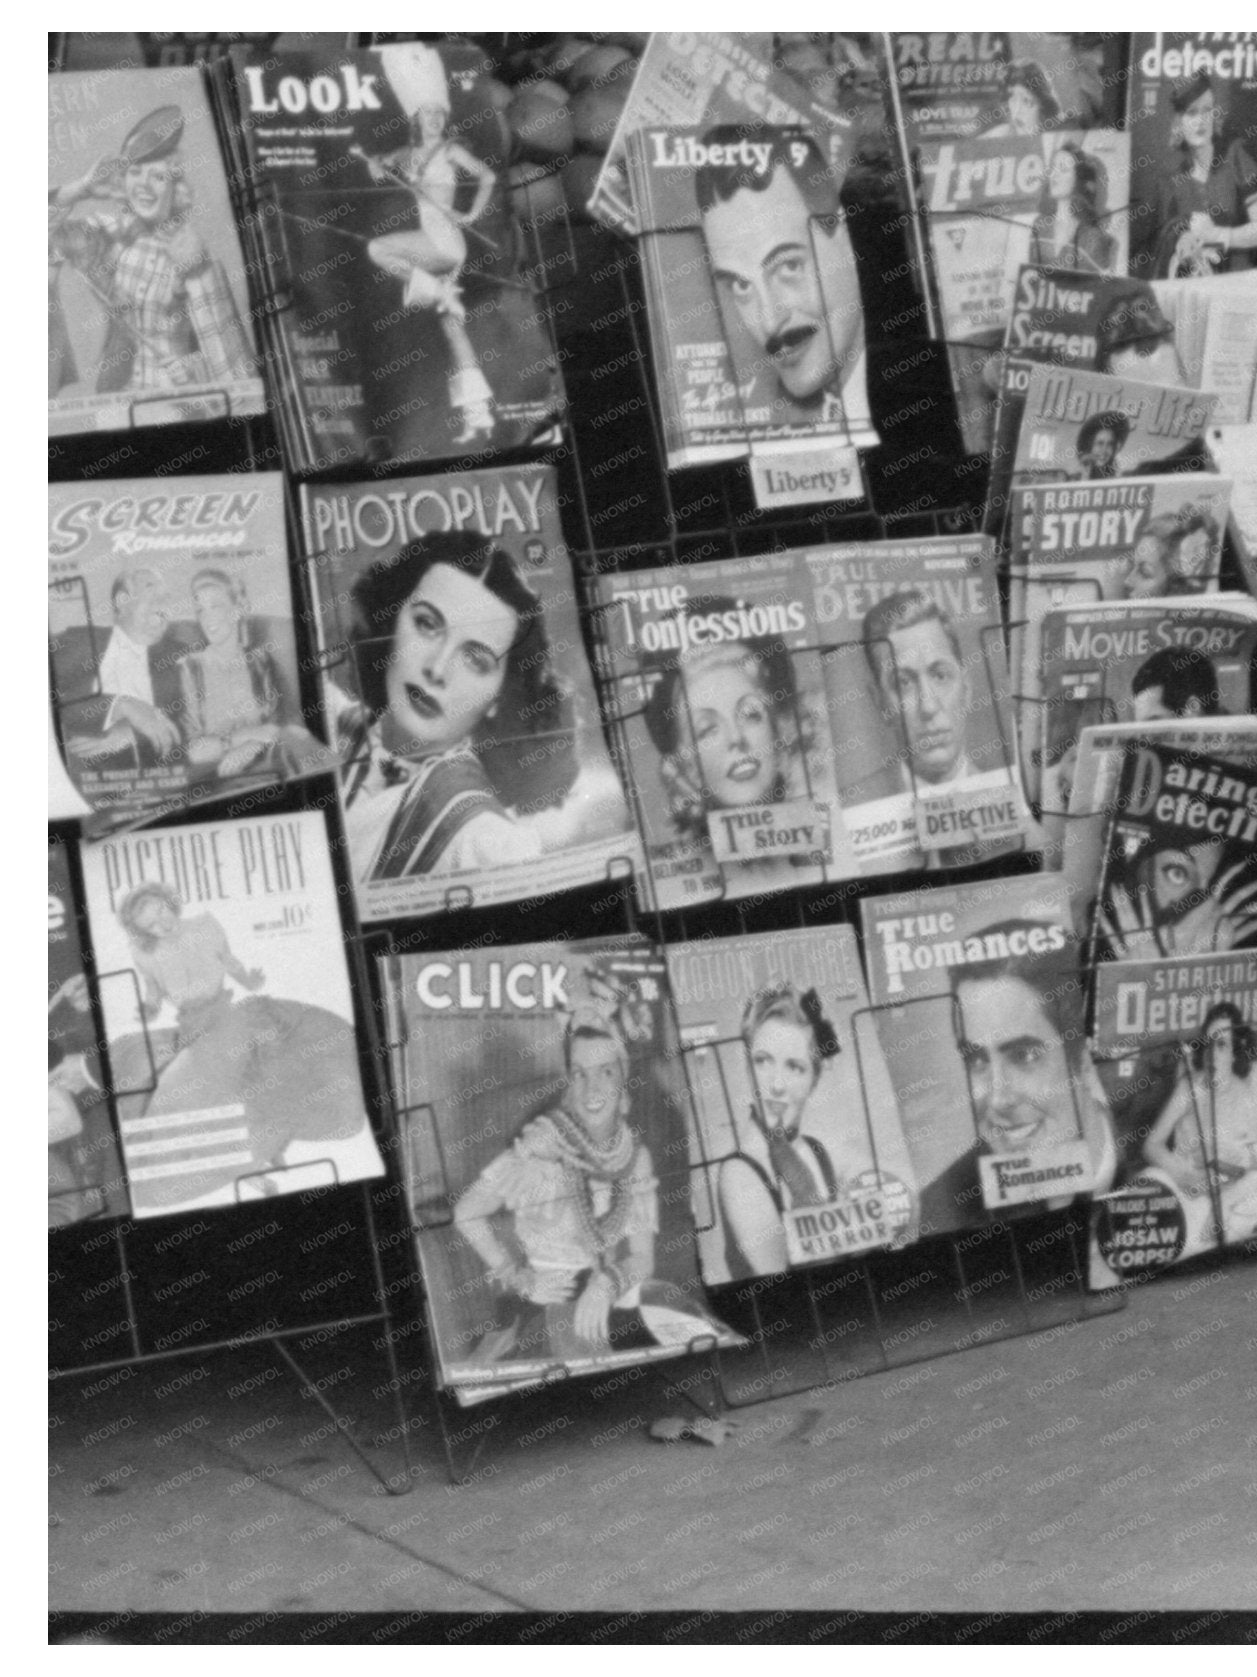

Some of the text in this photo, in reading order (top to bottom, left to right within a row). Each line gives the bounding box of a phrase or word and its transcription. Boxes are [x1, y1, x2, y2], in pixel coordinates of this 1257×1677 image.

[245, 64, 382, 113] Look
[650, 131, 773, 175] Liberty
[1016, 268, 1095, 314] Silver
[1013, 311, 1098, 359] Screen
[764, 467, 838, 495] Liberty
[48, 491, 262, 561] SCREEN
[314, 478, 547, 552] PHOTOPLAY
[1041, 509, 1145, 550] STORY
[720, 807, 775, 854] True
[924, 801, 1020, 838] DETECTIVE
[238, 820, 307, 897] PLAY
[885, 923, 1066, 976] Romances
[415, 961, 569, 1011] CLICK
[998, 1162, 1085, 1188] Romances
[793, 1197, 885, 1240] movie
